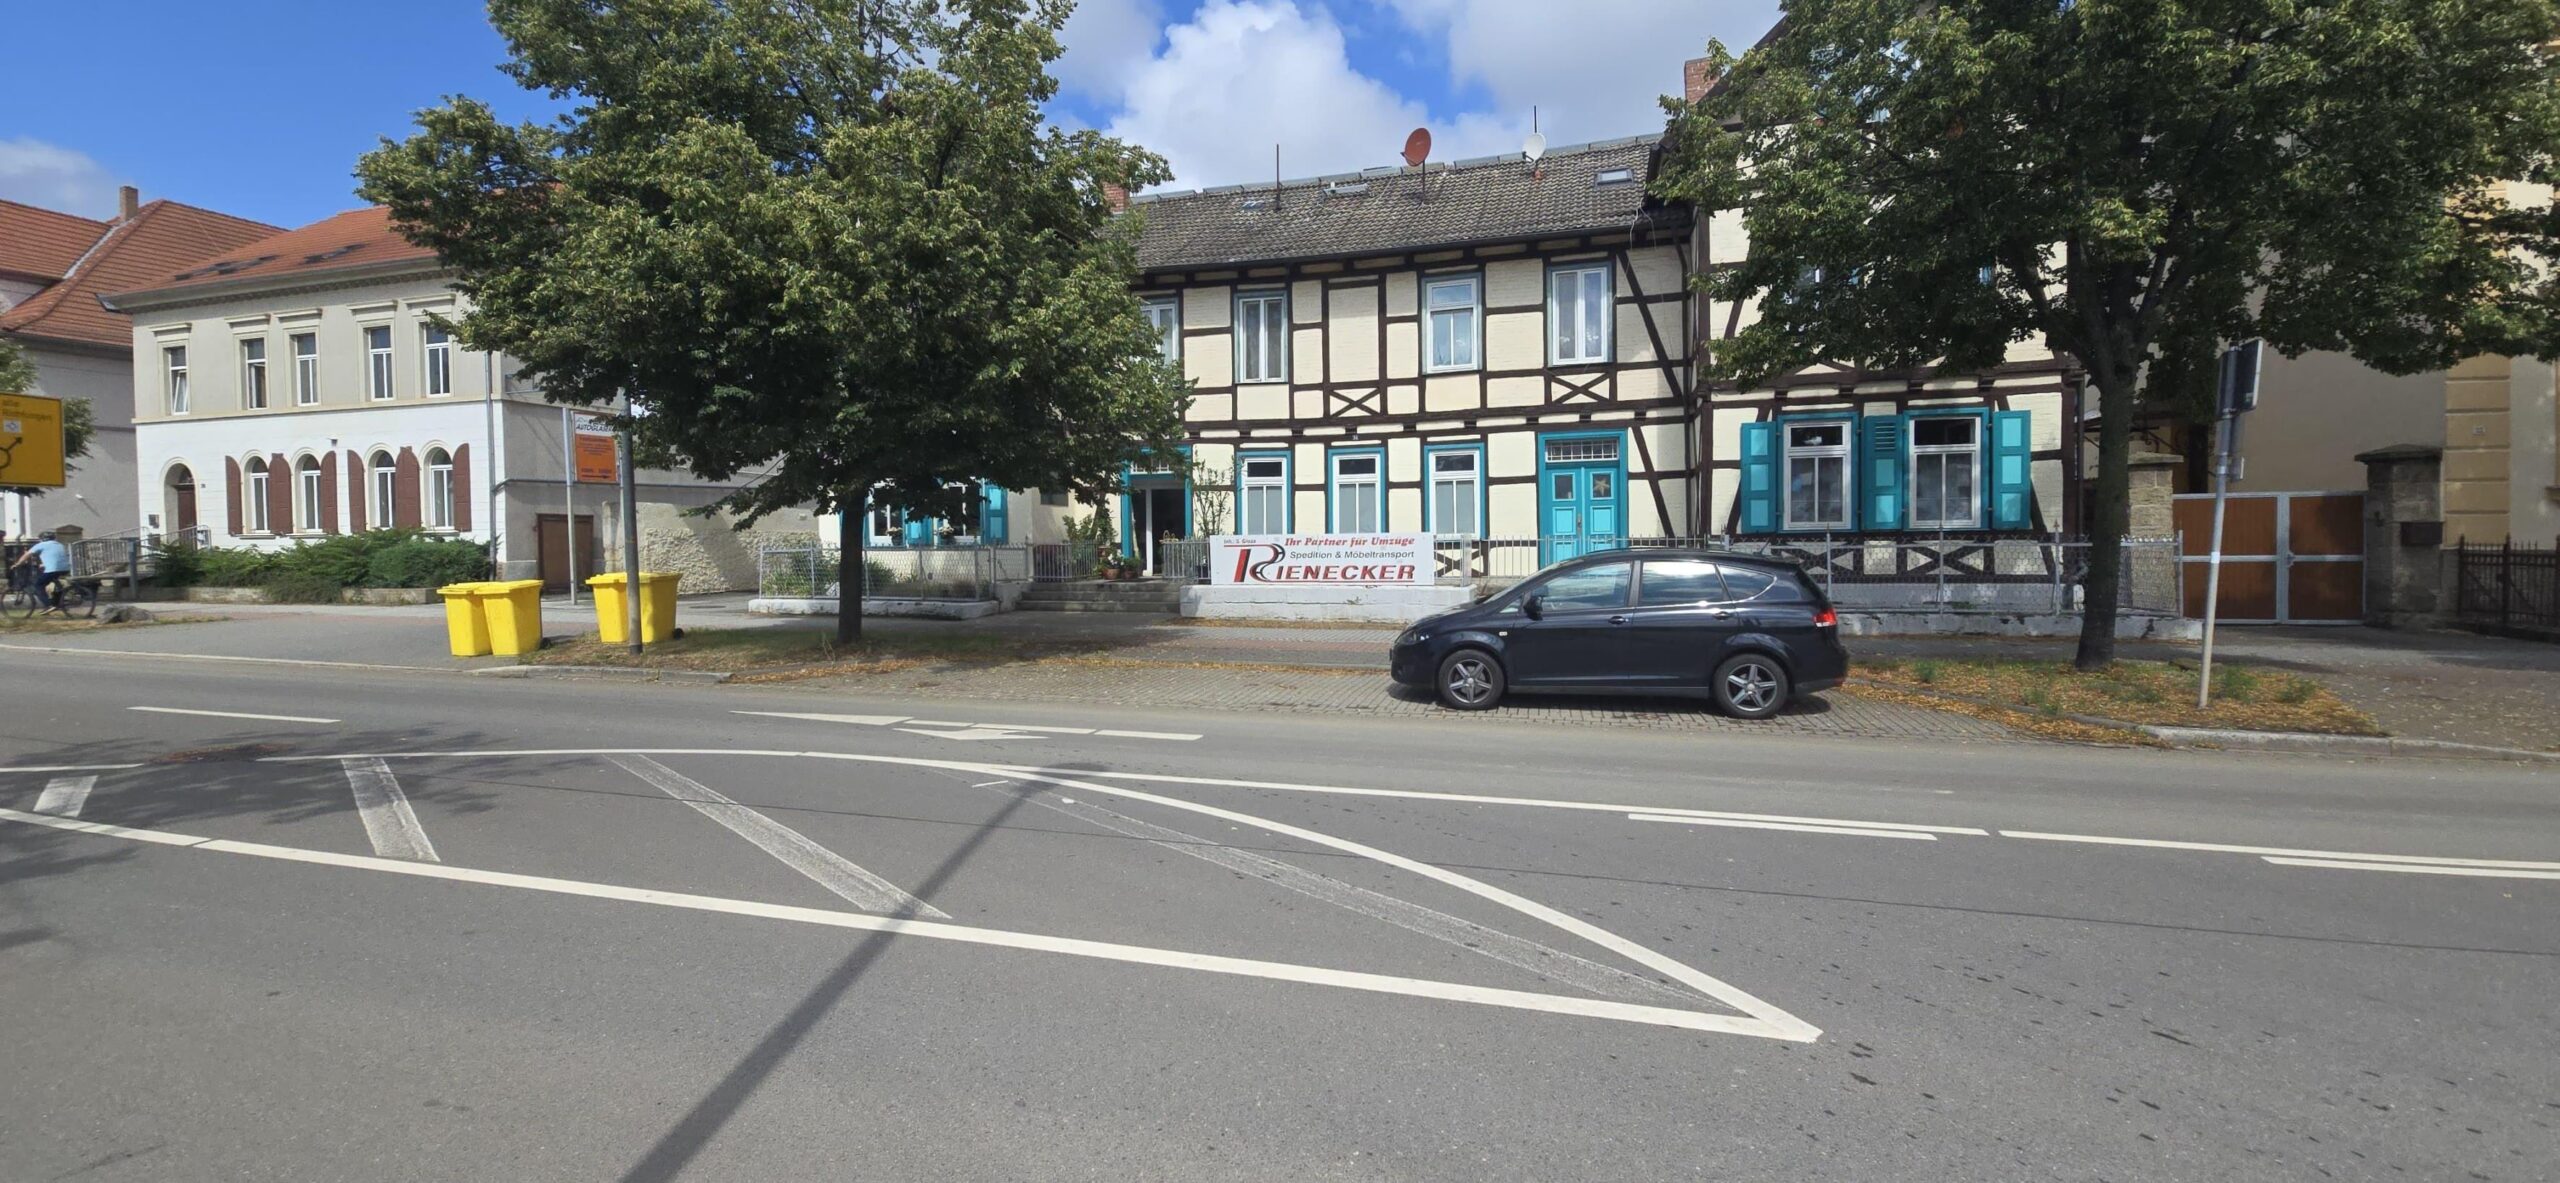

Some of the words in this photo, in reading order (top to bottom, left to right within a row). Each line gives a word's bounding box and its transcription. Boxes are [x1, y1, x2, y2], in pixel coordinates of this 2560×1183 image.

[1285, 537, 1301, 546] Ihr
[1304, 537, 1348, 546] Partner
[1350, 536, 1367, 547] für
[1371, 536, 1415, 547] Umzüge
[1290, 551, 1332, 561] Spedition
[1335, 551, 1342, 559] &
[1344, 550, 1415, 560] Möbeltransport
